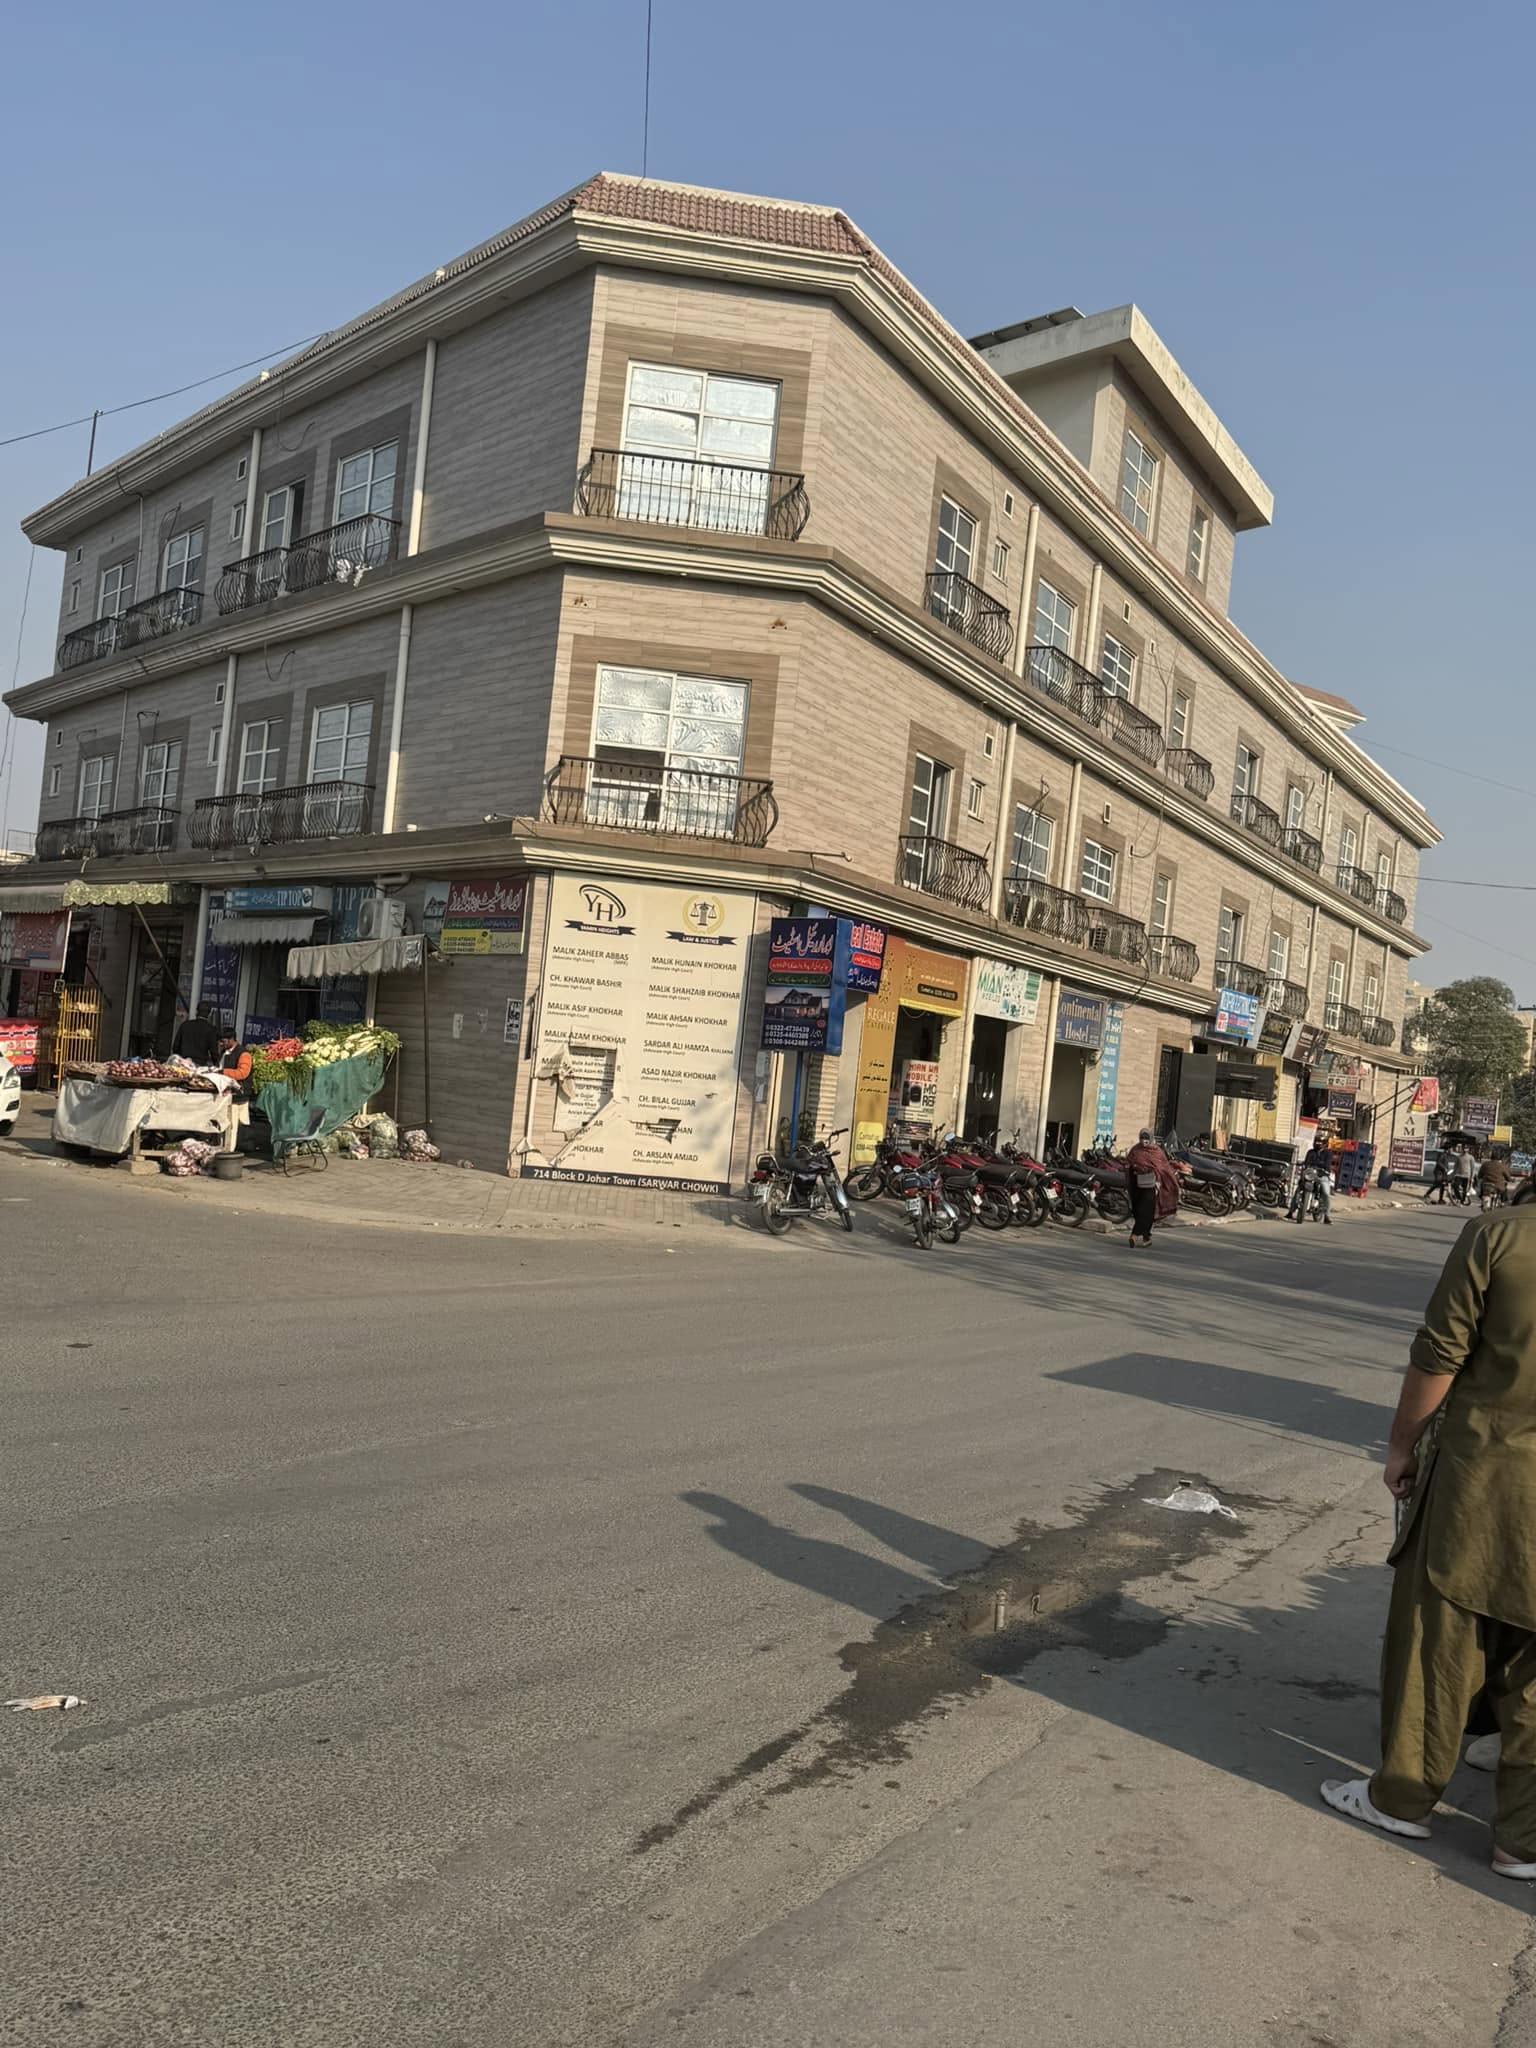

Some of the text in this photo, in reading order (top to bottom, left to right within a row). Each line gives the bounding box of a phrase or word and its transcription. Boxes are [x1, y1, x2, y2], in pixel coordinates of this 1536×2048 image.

[553, 946, 629, 961] MALIK ZAHEER ABBAS
[651, 956, 737, 972] MALIK HUNAIN KHOKHAR
[563, 975, 595, 985] KHAWAR
[596, 978, 622, 988] BASHIR
[648, 984, 740, 1000] MALIK SHAHZAIB KHOKHAR
[547, 1002, 623, 1016] MALIK ASIF KHOKHAR
[646, 1012, 728, 1026] MALIK AHSAN KHOKHAR
[545, 1030, 627, 1044] MALIK AZAM KHOKHAR
[1065, 1021, 1089, 1042] Hostel
[644, 1040, 671, 1048] SARDAR
[684, 1043, 709, 1052] HAMZA
[641, 1067, 716, 1081] ASAD NAZIR KHOKHAR
[652, 1096, 670, 1104] BILAL
[671, 1098, 696, 1107] GUJJAR
[572, 1145, 605, 1154] HOKHAR
[646, 1150, 672, 1160] ARSLAN
[674, 1153, 698, 1162] AMJAD
[533, 1169, 550, 1179] 714
[552, 1170, 576, 1180] Block
[578, 1173, 585, 1181] D
[586, 1174, 611, 1184] Johar
[613, 1176, 636, 1186] Town
[638, 1178, 680, 1191] (SARWAR
